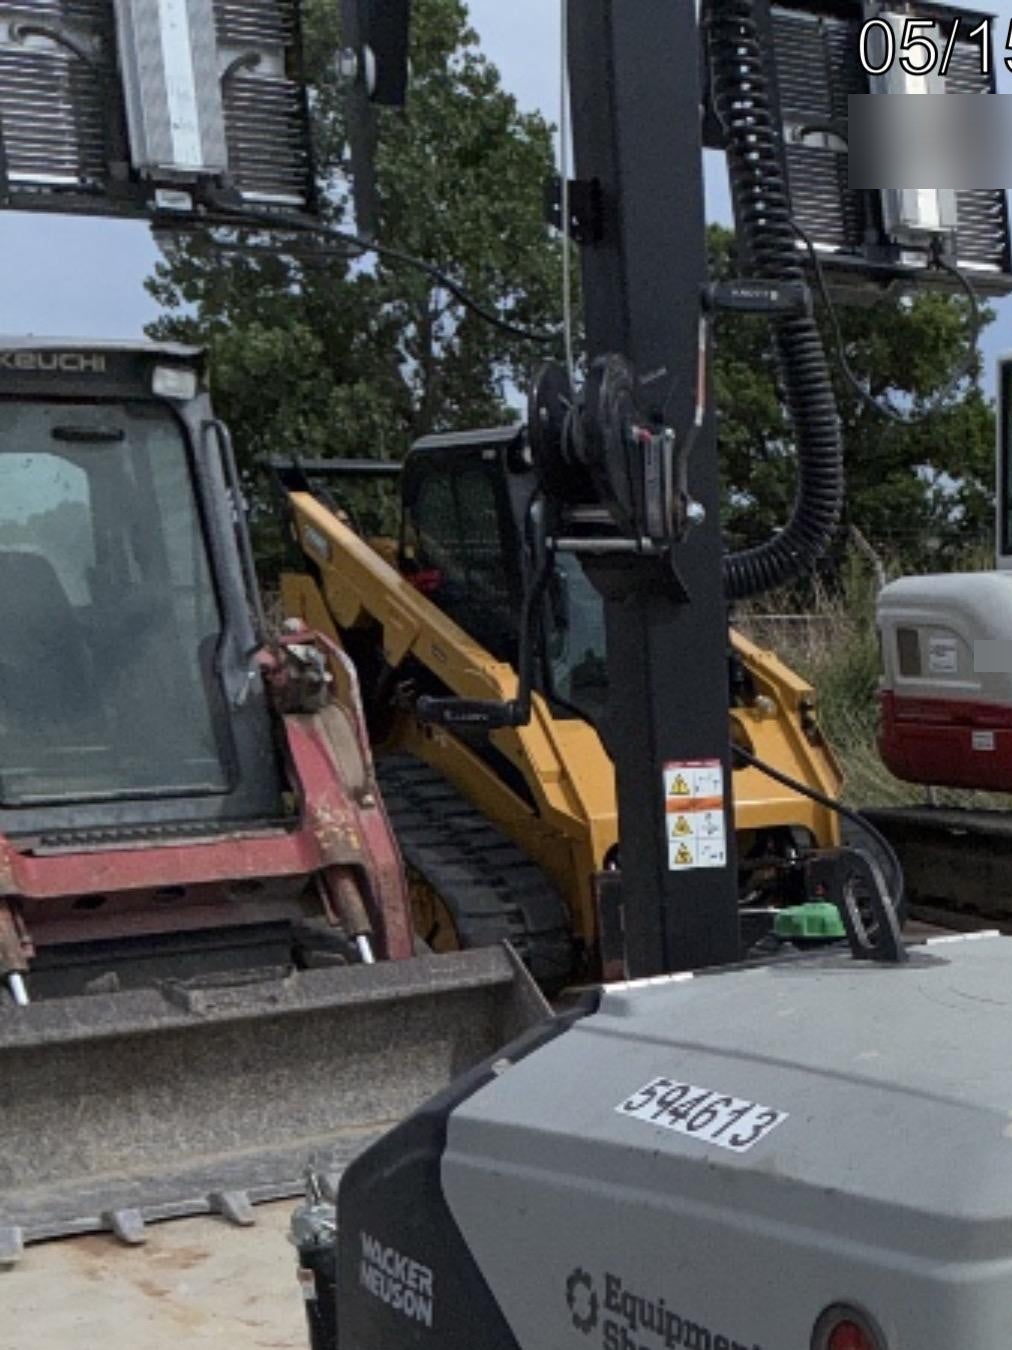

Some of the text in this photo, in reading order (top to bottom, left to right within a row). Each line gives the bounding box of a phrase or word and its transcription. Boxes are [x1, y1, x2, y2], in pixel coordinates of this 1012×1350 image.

[623, 1079, 779, 1147] 594613
[360, 1259, 433, 1328] NEUSON
[361, 1232, 433, 1297] WACKER
